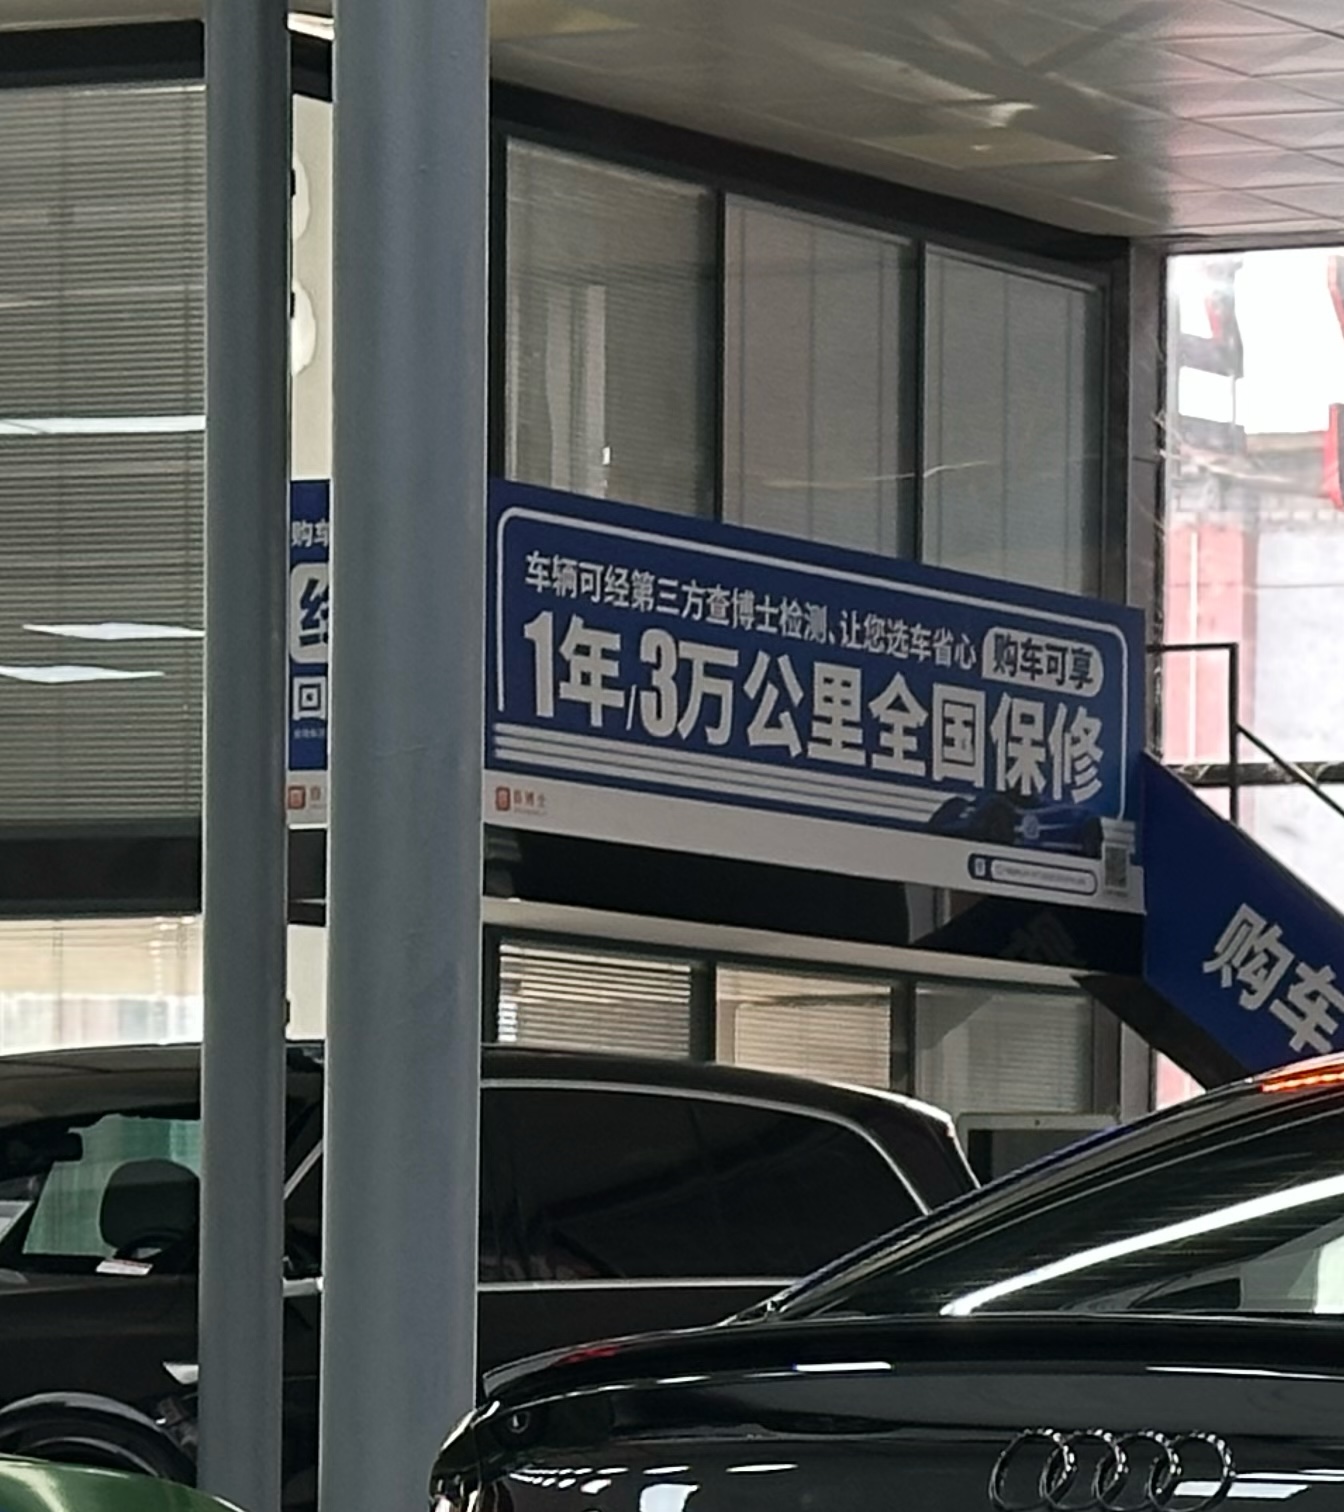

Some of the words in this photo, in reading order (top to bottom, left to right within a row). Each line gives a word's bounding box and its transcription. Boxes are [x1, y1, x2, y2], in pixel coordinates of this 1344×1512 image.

[524, 610, 1103, 804] 1年/3万公里全国保修
[993, 633, 1094, 690] 购车可享
